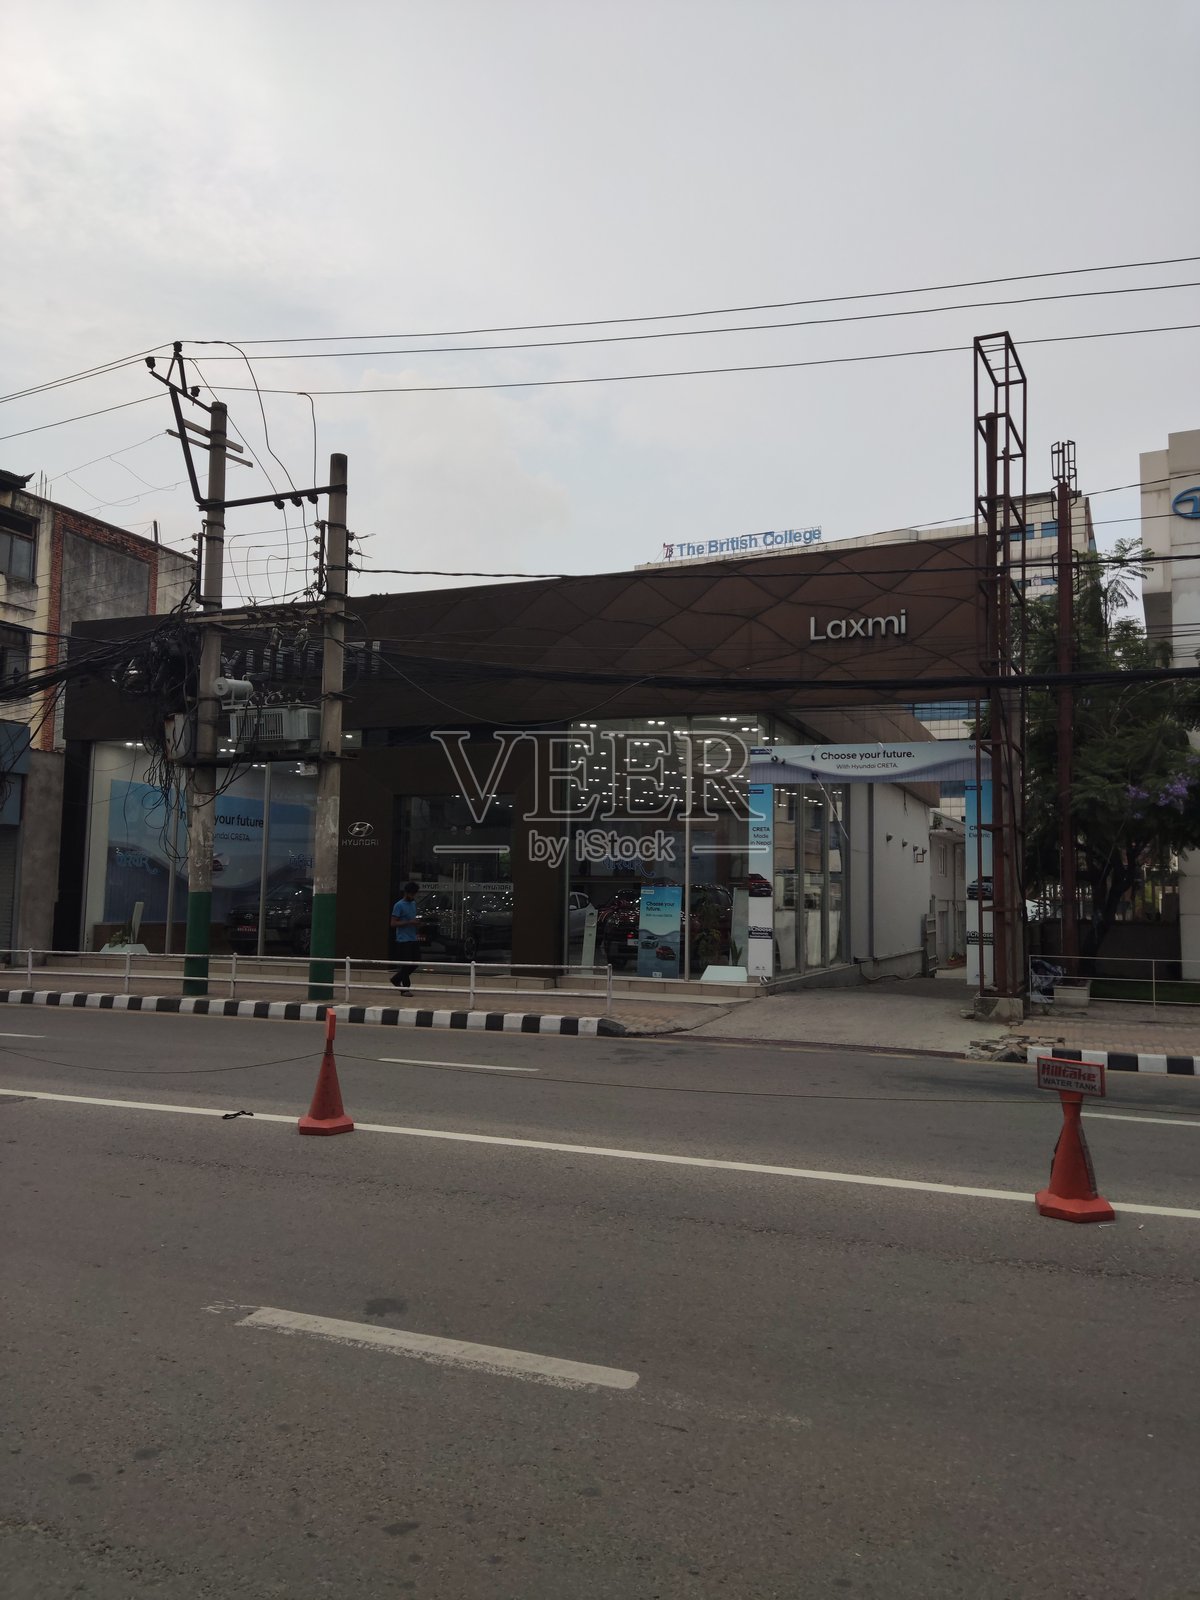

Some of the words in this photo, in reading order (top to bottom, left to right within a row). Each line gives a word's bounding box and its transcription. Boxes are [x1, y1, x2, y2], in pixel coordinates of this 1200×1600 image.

[677, 543, 704, 557] The
[708, 536, 757, 553] British
[763, 528, 822, 545] College
[810, 608, 907, 640] Laxmi
[821, 752, 857, 760] Choose
[859, 752, 881, 761] your
[882, 750, 915, 758] future.
[214, 815, 235, 826] your
[1043, 1077, 1072, 1088] WATER
[1074, 1081, 1097, 1092] TANK
